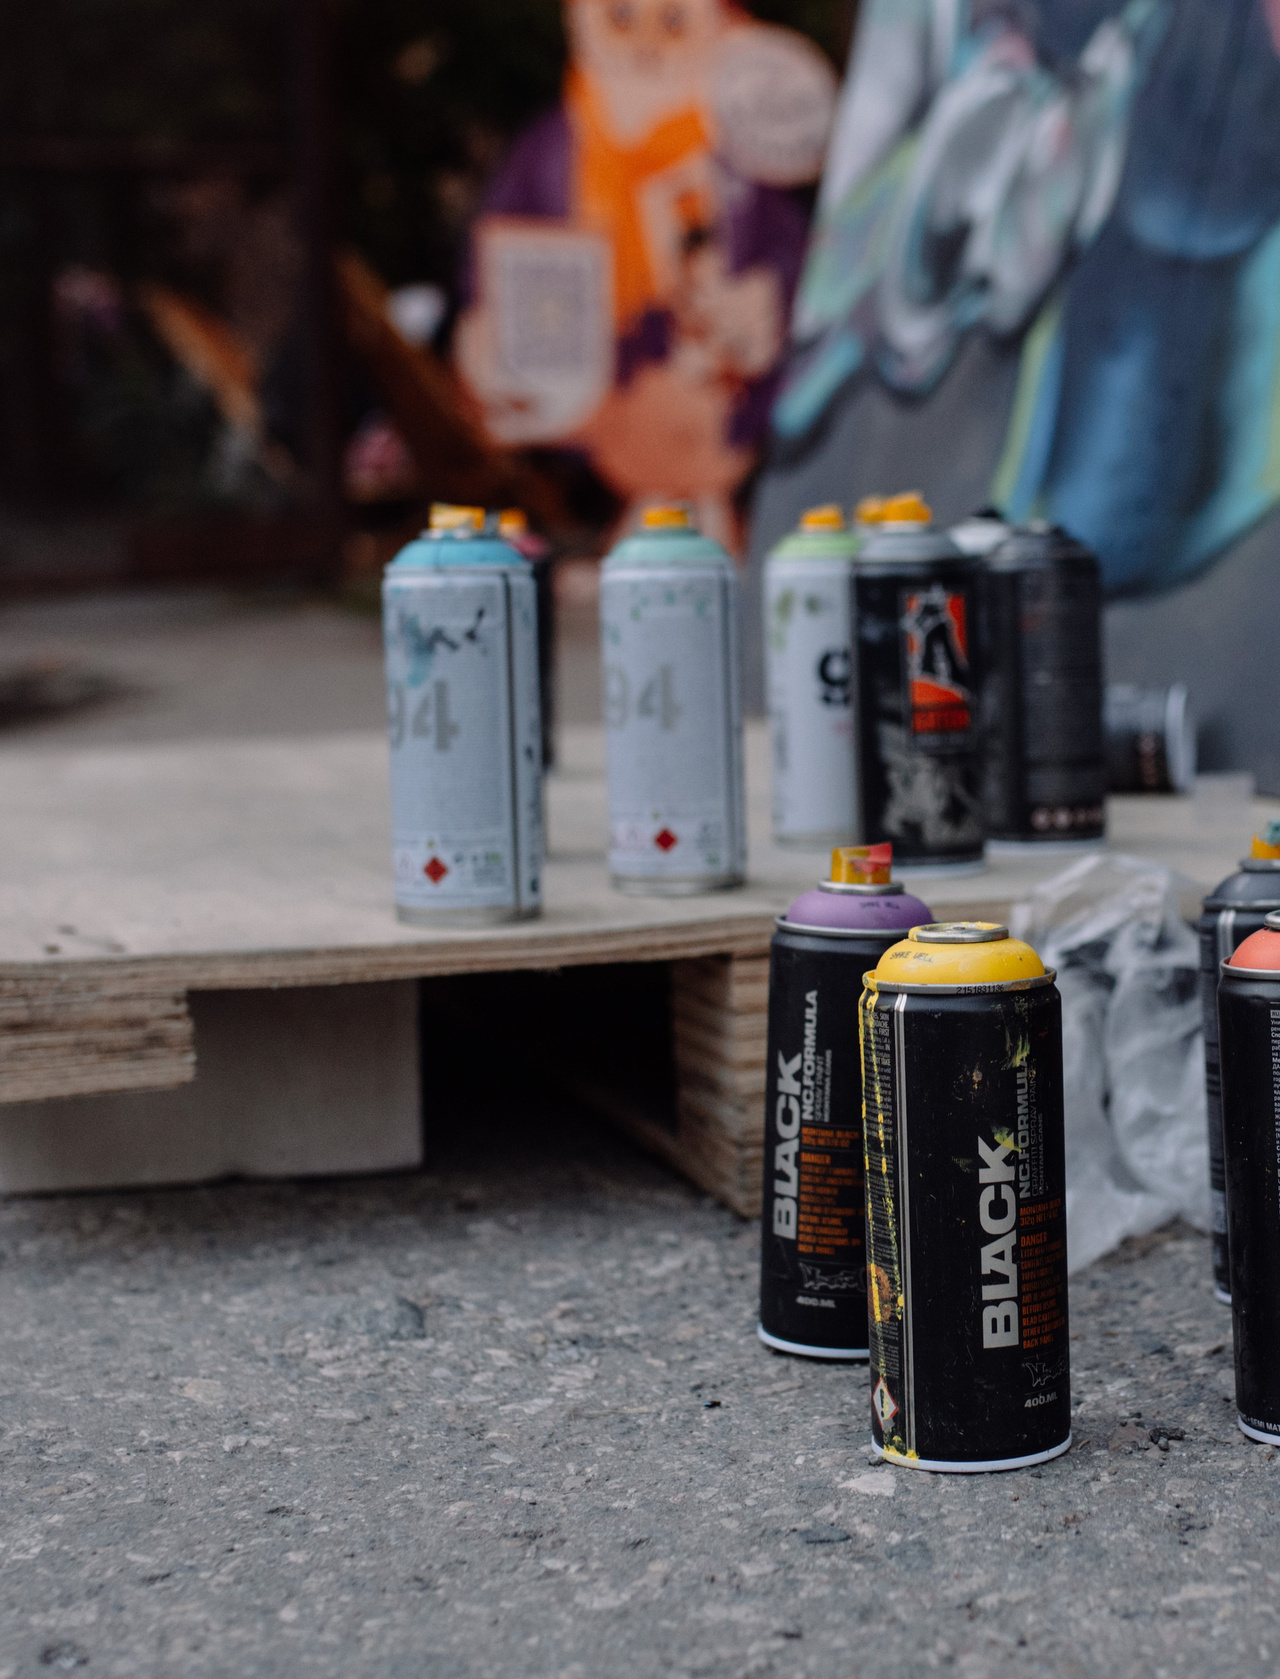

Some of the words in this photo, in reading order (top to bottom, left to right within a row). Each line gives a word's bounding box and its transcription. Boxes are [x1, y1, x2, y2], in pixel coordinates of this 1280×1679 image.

[802, 990, 818, 1121] NC.FORMULA
[1017, 1054, 1031, 1199] NC.FORMULA
[772, 1049, 802, 1240] BLACK
[978, 1132, 1019, 1349] BLACK
